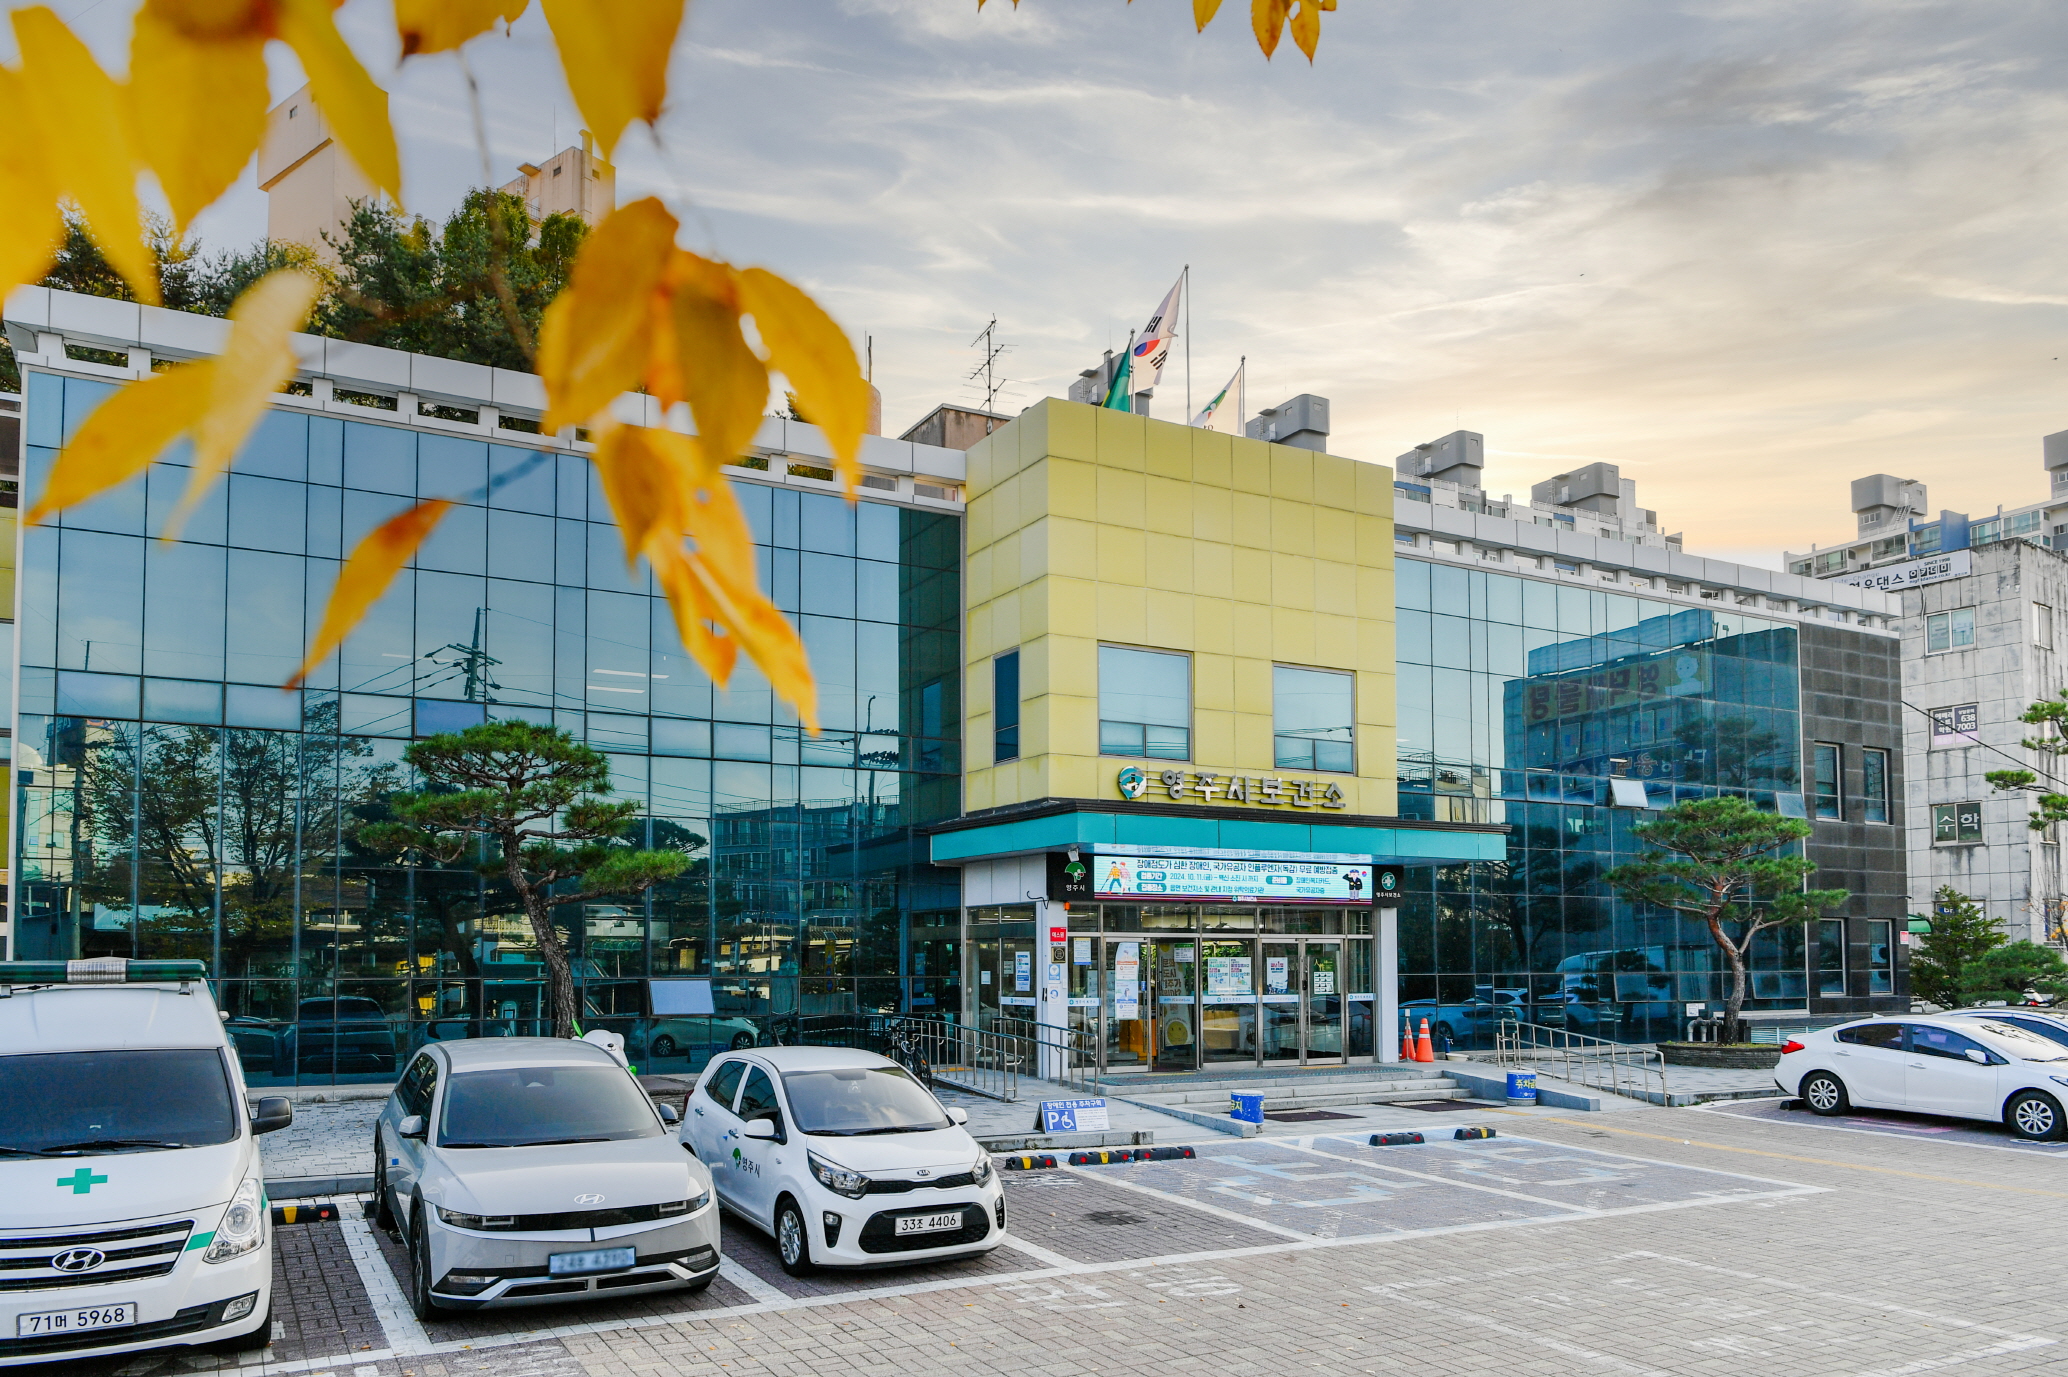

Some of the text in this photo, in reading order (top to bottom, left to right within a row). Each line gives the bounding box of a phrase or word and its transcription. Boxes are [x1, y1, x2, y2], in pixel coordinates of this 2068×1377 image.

[1960, 713, 1976, 722] 638
[1956, 722, 1976, 731] 7003
[1162, 770, 1347, 808] 영주시보건소
[1938, 812, 1980, 832] 수학
[1136, 859, 1172, 869] 장애정도가
[1173, 860, 1188, 870] 심한
[1189, 861, 1212, 871] 장애인,
[1213, 862, 1247, 872] 국가유공자
[1299, 865, 1312, 873] 무료
[1065, 884, 1085, 892] 영주시
[1046, 1099, 1102, 1109] 장애인 전용 주차구역
[1047, 1111, 1060, 1130] P
[742, 1156, 761, 1178] 영주시
[901, 1214, 957, 1231] 33조 4406
[30, 1307, 125, 1332] 71머 5968
